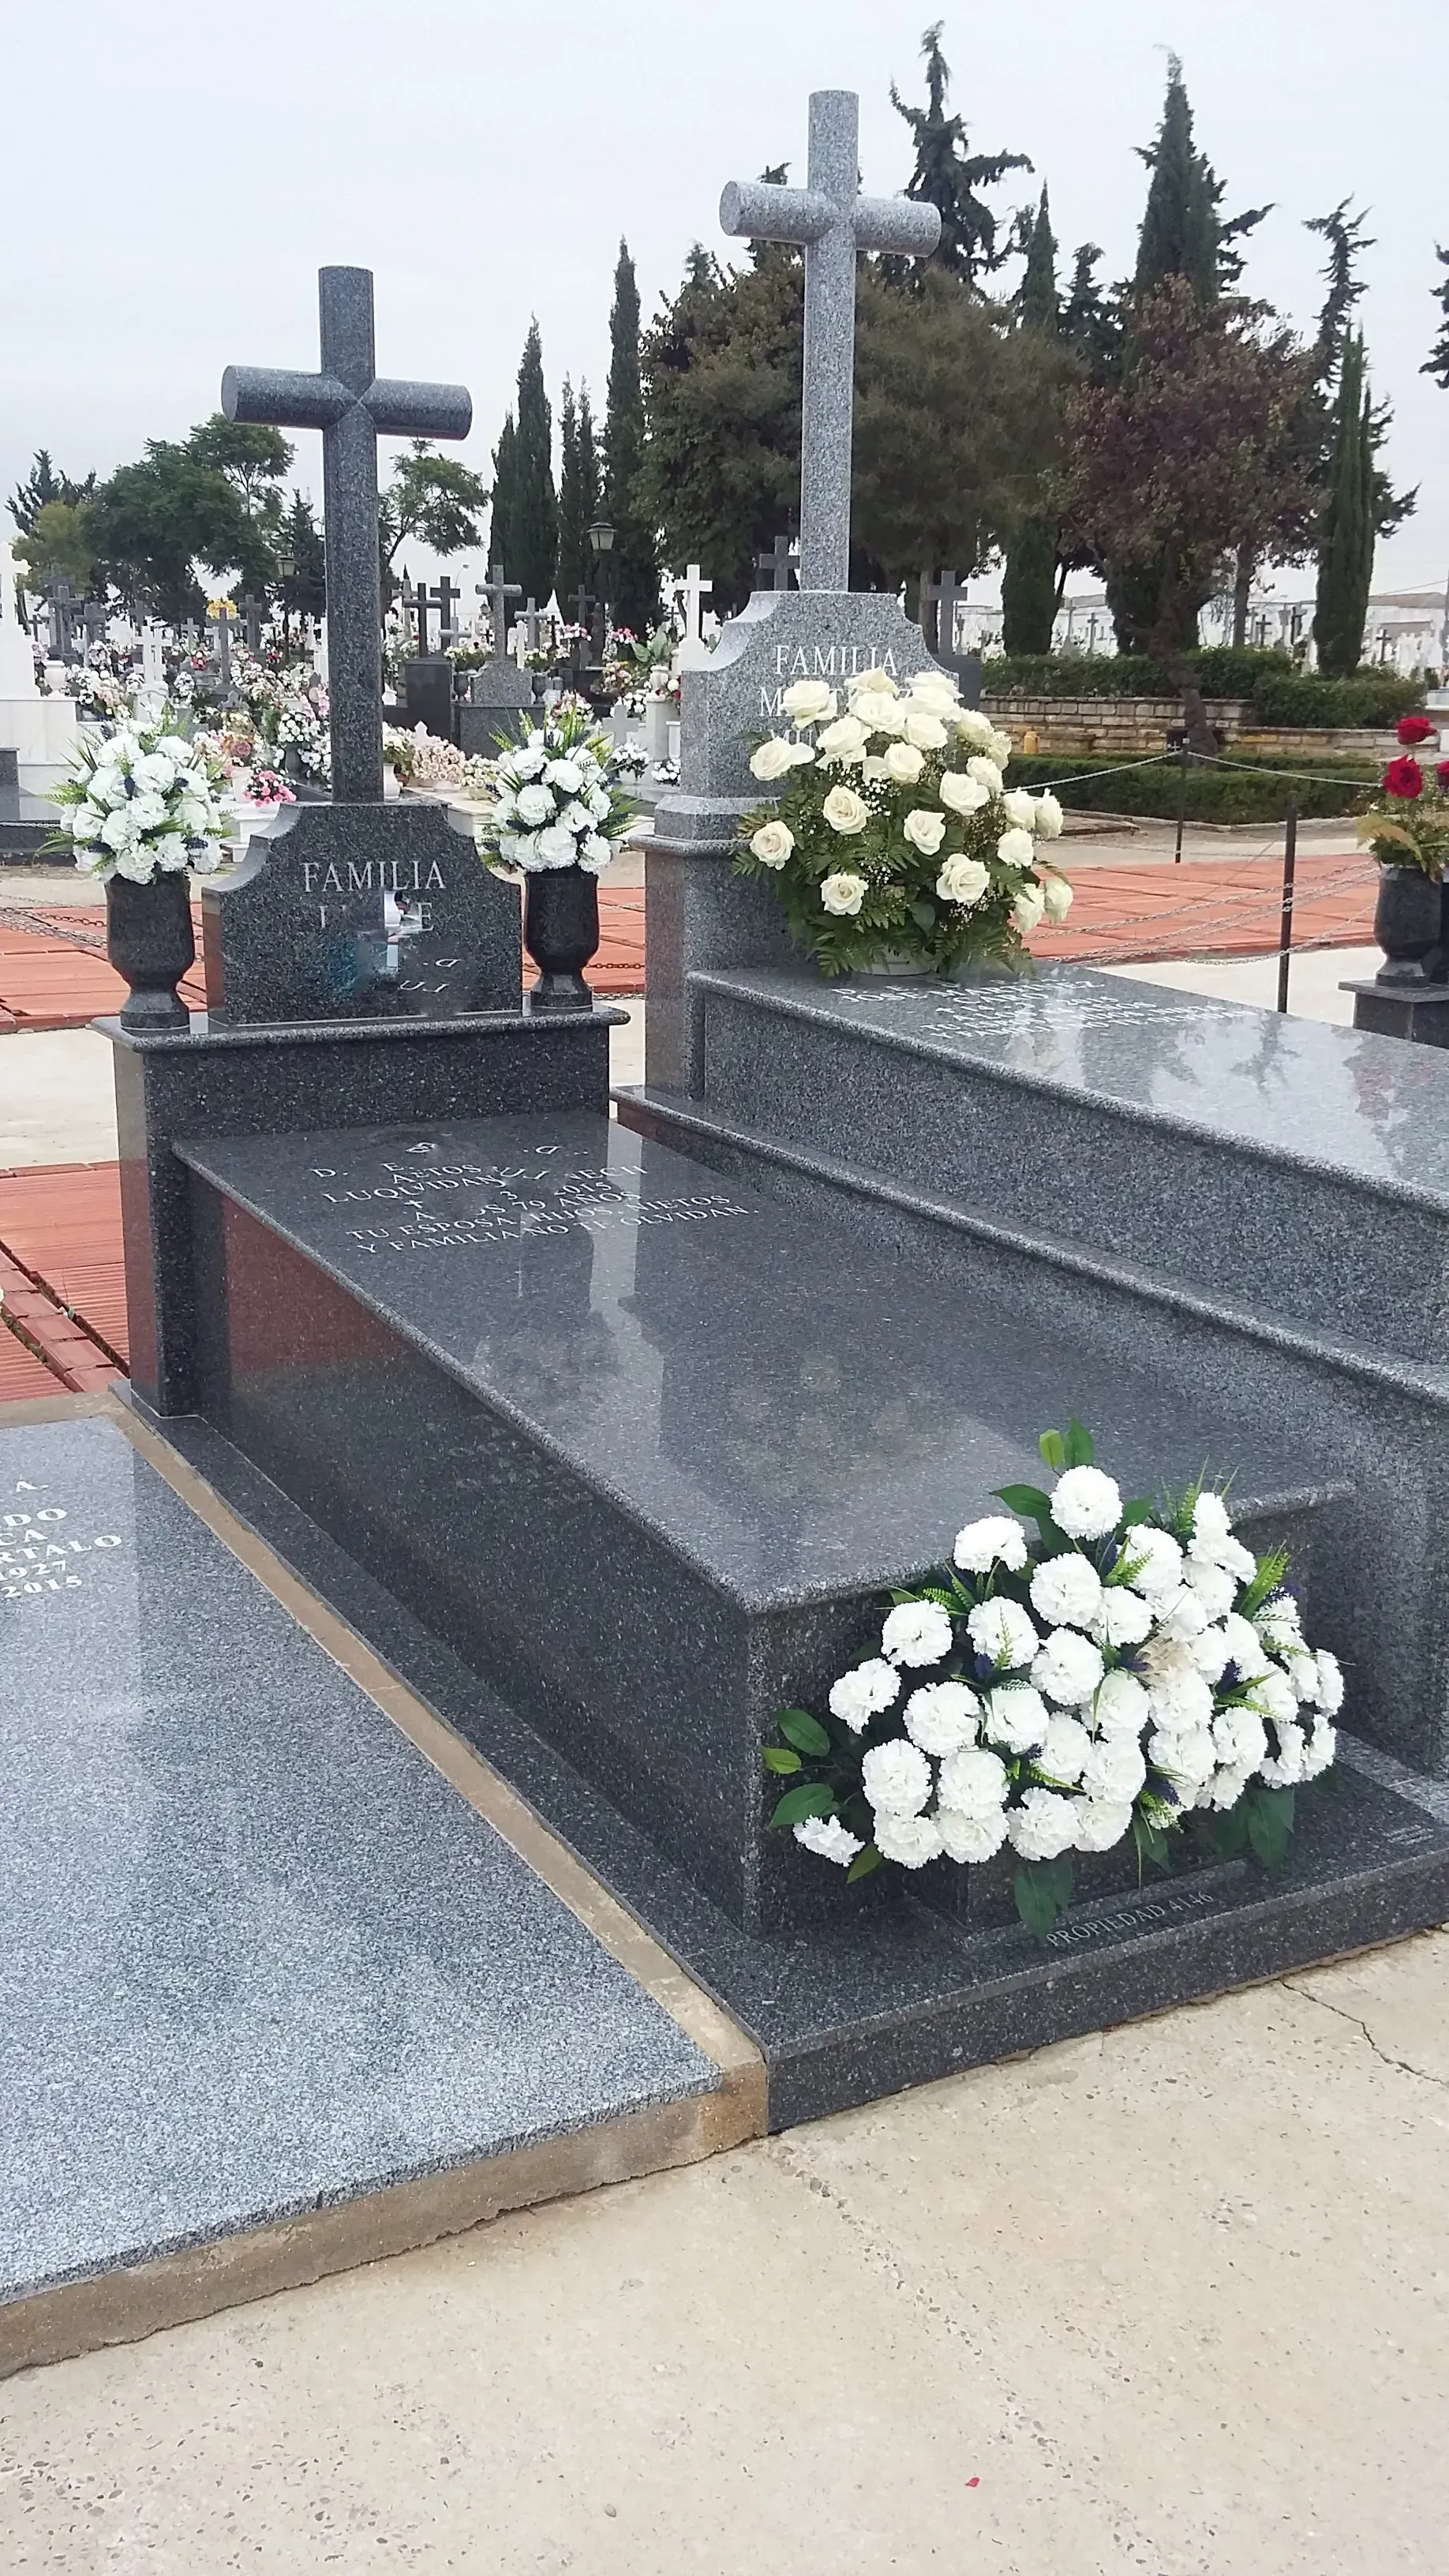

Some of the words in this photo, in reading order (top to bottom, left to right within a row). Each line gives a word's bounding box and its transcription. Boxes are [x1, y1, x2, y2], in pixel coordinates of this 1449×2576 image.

[775, 644, 900, 676] FAMILIA
[301, 859, 446, 893] FAMILIA
[953, 993, 1050, 1003] CARO
[511, 1199, 546, 1211] 79
[559, 1190, 642, 1208] AÑOS
[345, 1227, 390, 1240] TU
[626, 1194, 731, 1213] NIETOS
[357, 1243, 377, 1253] Y
[388, 1229, 521, 1252] FAMILIA
[524, 1223, 570, 1237] NO
[1, 1575, 83, 1597] 2015
[1046, 1904, 1166, 1946] PROPIEDAD
